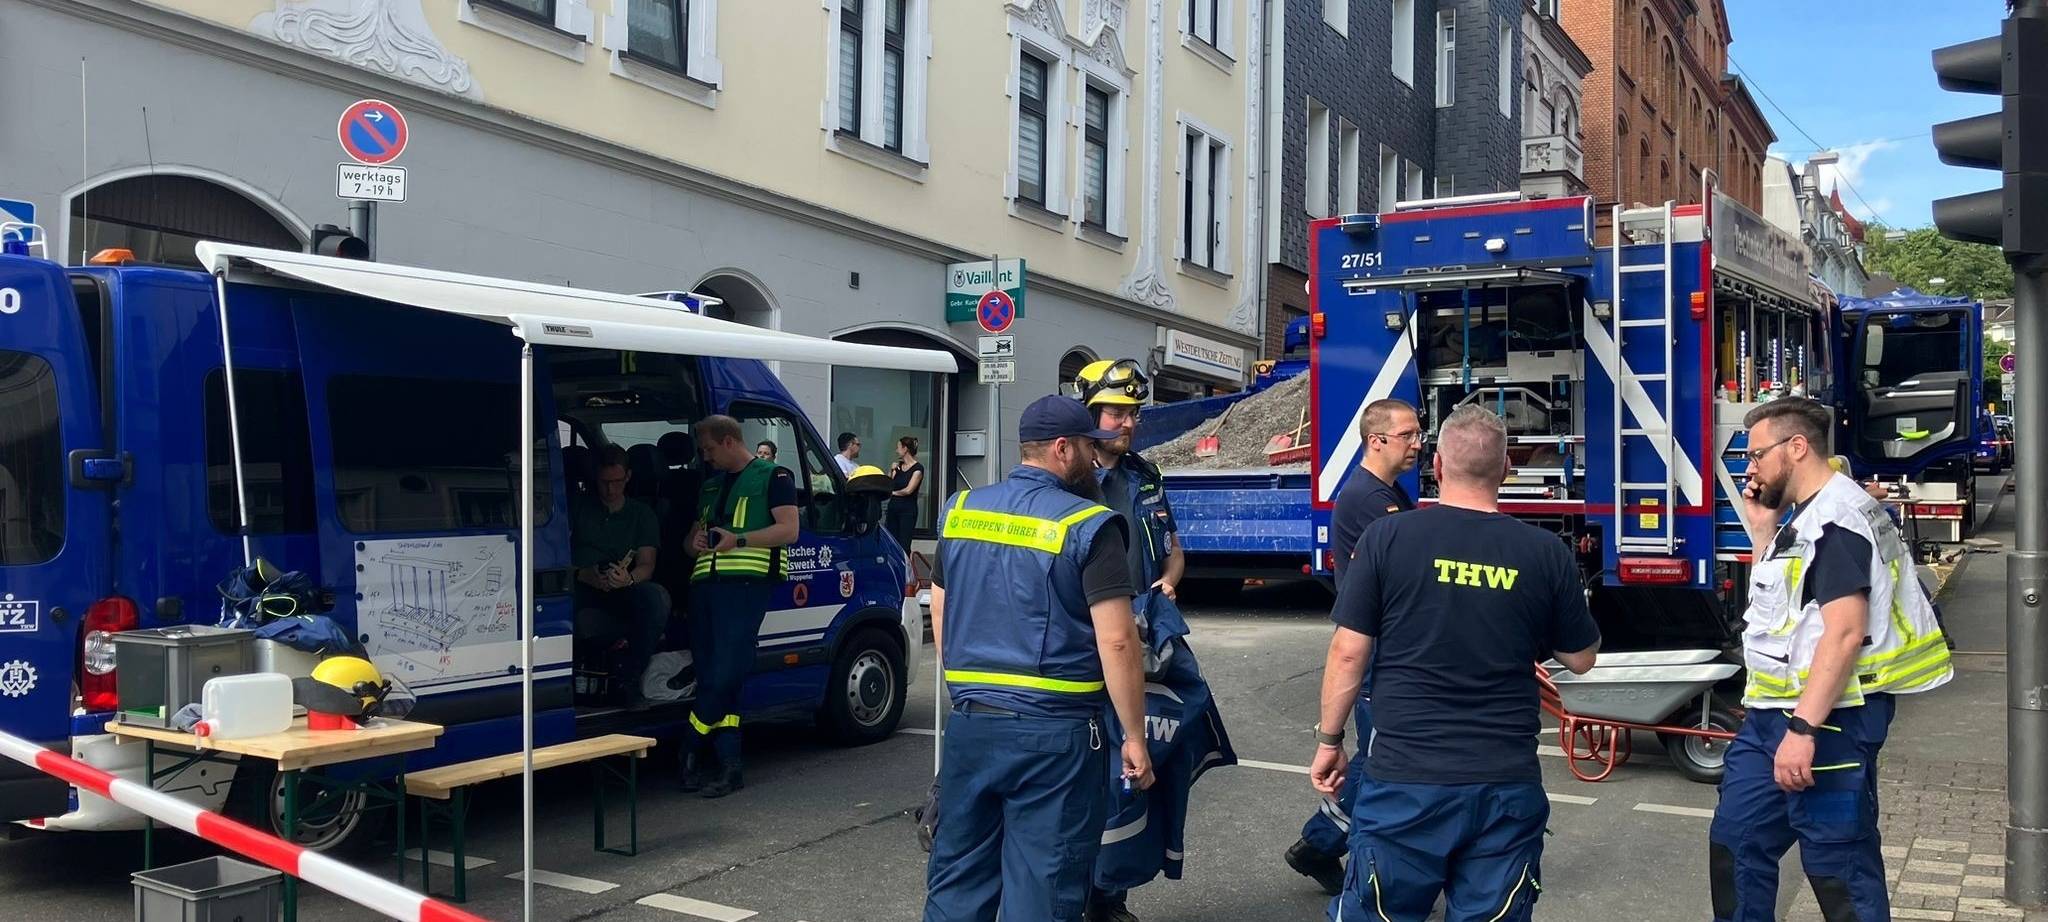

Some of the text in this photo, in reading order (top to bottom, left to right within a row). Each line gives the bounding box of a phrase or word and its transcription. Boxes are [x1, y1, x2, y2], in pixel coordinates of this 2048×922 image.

[343, 171, 401, 186] werktags
[354, 182, 362, 194] 7
[1341, 251, 1382, 269] 27/51
[966, 270, 1013, 285] Vaillnt
[961, 518, 1037, 539] GRUPPENFÜHRER
[1434, 559, 1519, 590] THW
